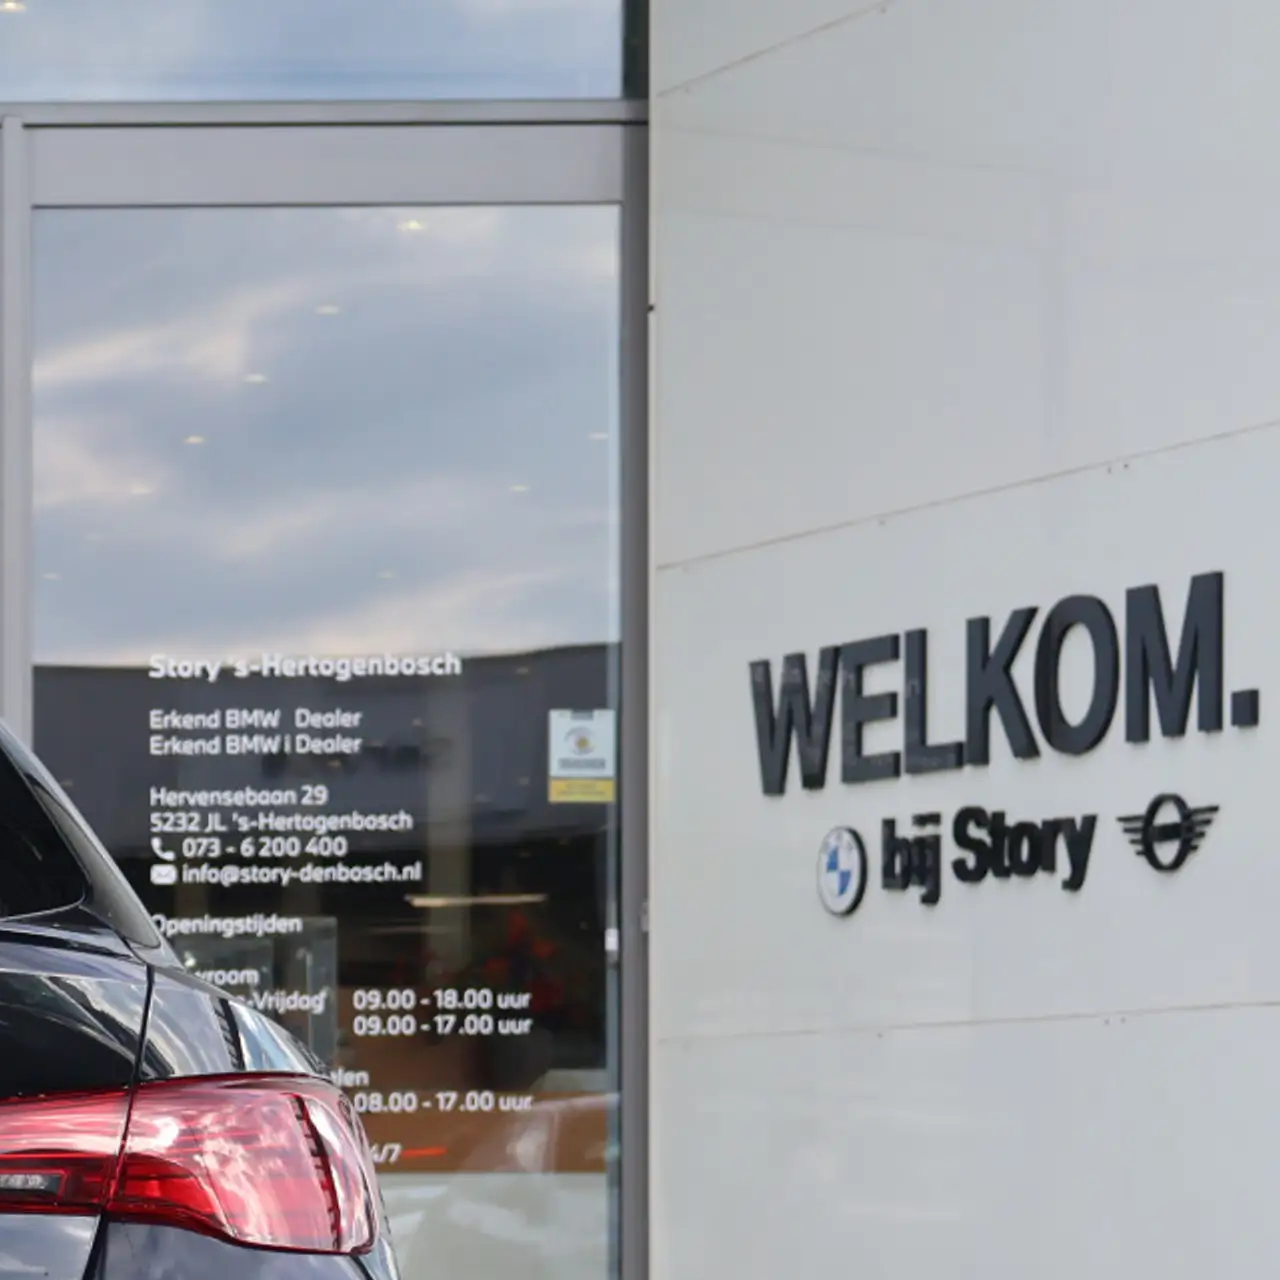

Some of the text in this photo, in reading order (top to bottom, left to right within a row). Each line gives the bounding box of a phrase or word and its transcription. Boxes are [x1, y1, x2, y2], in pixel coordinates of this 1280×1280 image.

[148, 652, 461, 682] Story 's-Hertogenbosch
[749, 570, 1260, 798] WELKOM.
[149, 707, 362, 729] Erkend BMW Dealer
[149, 733, 362, 755] Erkend BMW i Dealer
[150, 785, 329, 806] Hervensebaan 29
[150, 813, 200, 832] 5232
[204, 813, 227, 832] JL
[182, 838, 221, 858] 073
[240, 837, 253, 856] 6
[258, 837, 300, 856] 200
[305, 836, 348, 855] 400
[882, 806, 1098, 904] bij Story
[182, 861, 422, 886] info@story-denbosch.nl
[150, 913, 303, 938] Openingstijden
[353, 990, 415, 1010] 09.00
[434, 989, 493, 1010] 18.00
[497, 991, 533, 1009] uur
[353, 1015, 416, 1035] 09.00
[498, 1016, 533, 1034] uur
[354, 1092, 417, 1112] 08.00
[498, 1094, 534, 1112] uur
